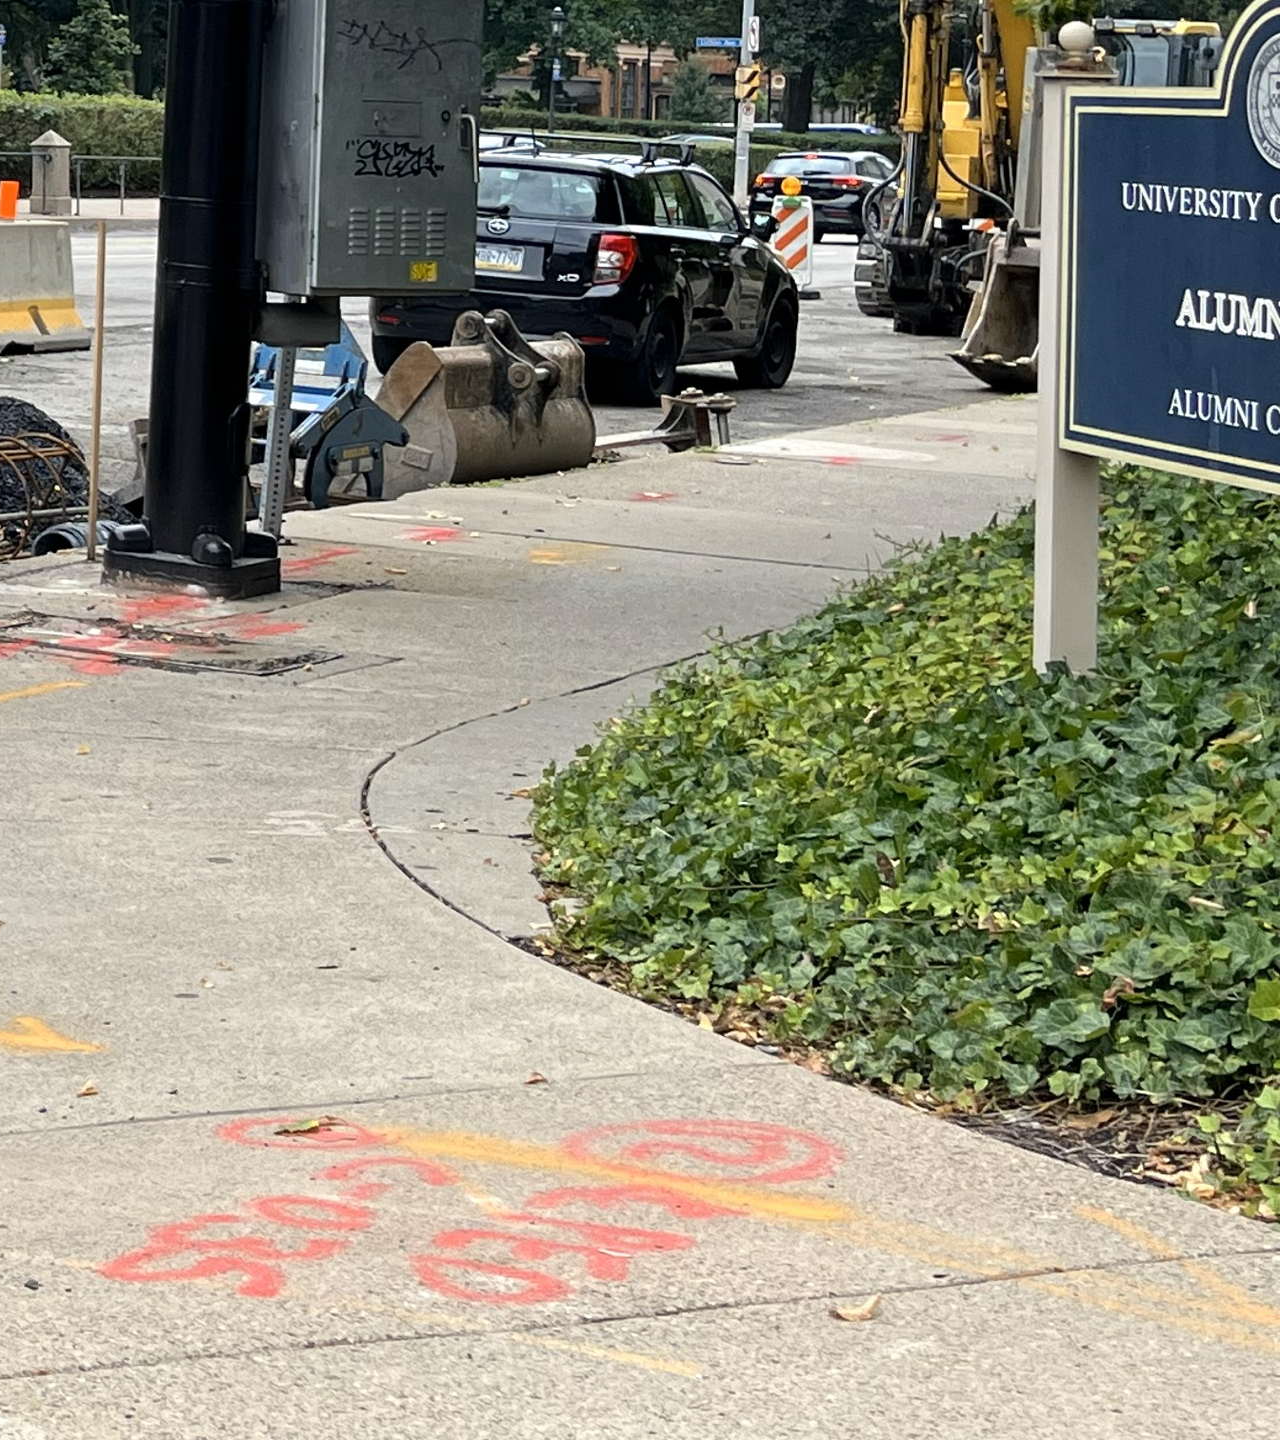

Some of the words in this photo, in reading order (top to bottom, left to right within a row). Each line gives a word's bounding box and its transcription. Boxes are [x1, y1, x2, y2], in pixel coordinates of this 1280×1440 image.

[1121, 182, 1262, 221] UNIVERSITY
[1176, 289, 1280, 340] ALUMN
[1168, 388, 1259, 431] ALUMNI
